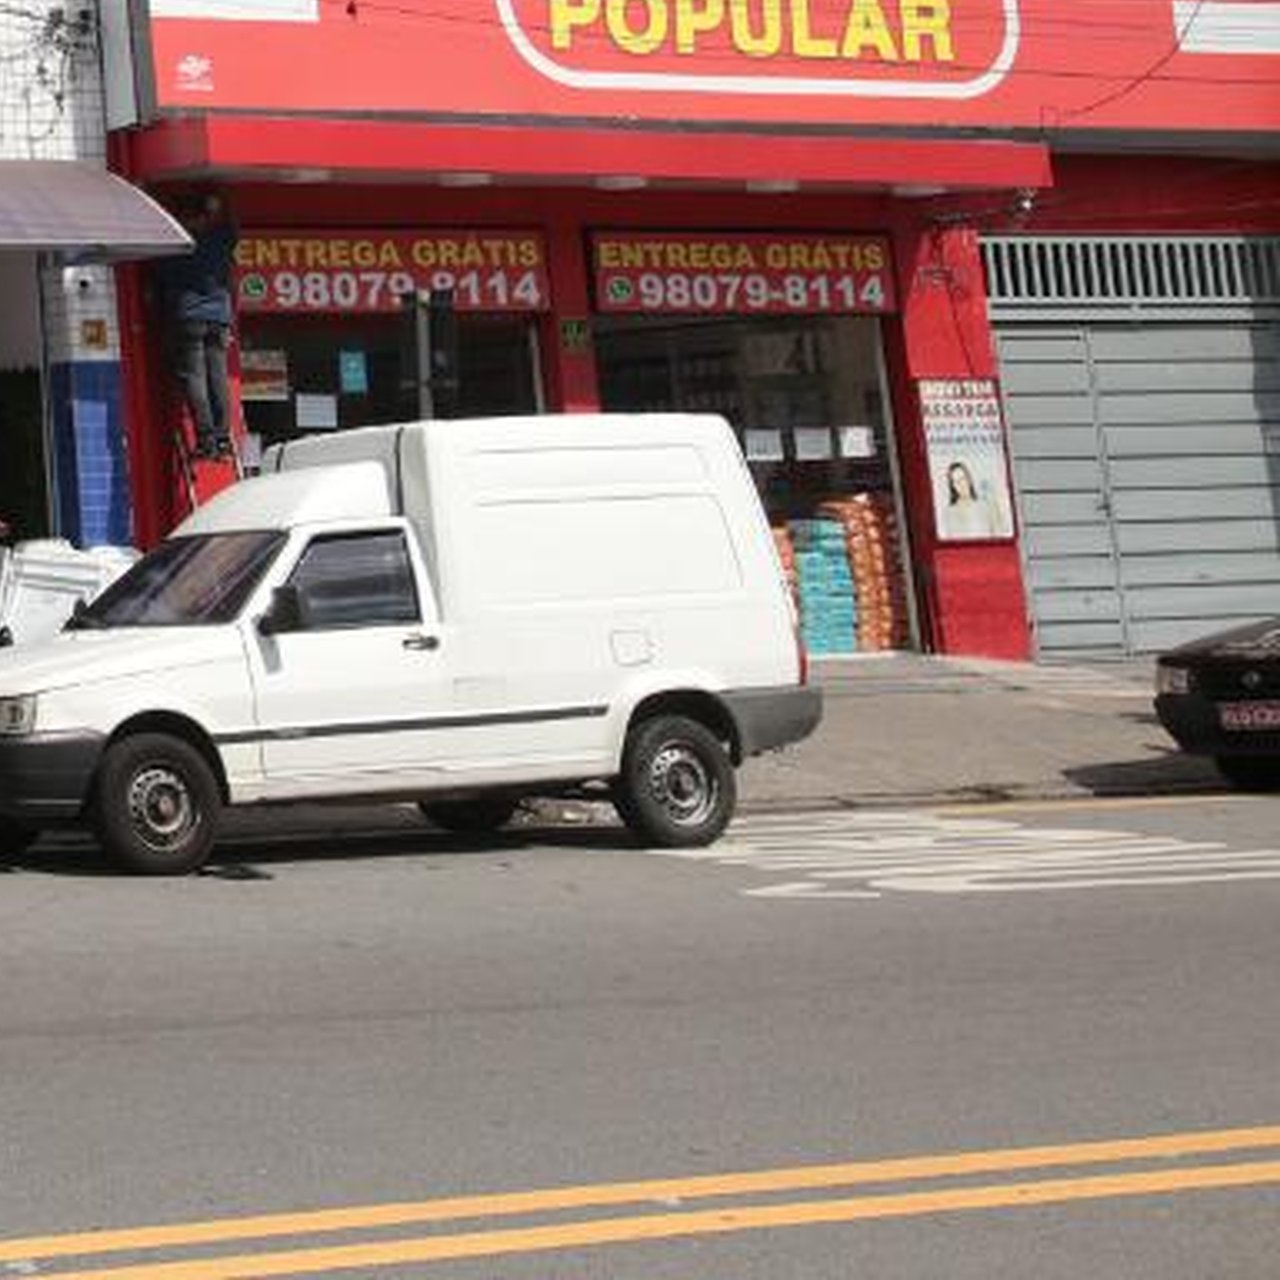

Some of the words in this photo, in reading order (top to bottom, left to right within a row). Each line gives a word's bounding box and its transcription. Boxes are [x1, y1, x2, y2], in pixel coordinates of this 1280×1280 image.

[233, 239, 403, 268] ENTREGA
[413, 234, 539, 267] GRÁTIS
[598, 242, 755, 269] ENTREGA
[766, 238, 885, 271] GRÁTIS
[638, 272, 886, 309] 98079-8114
